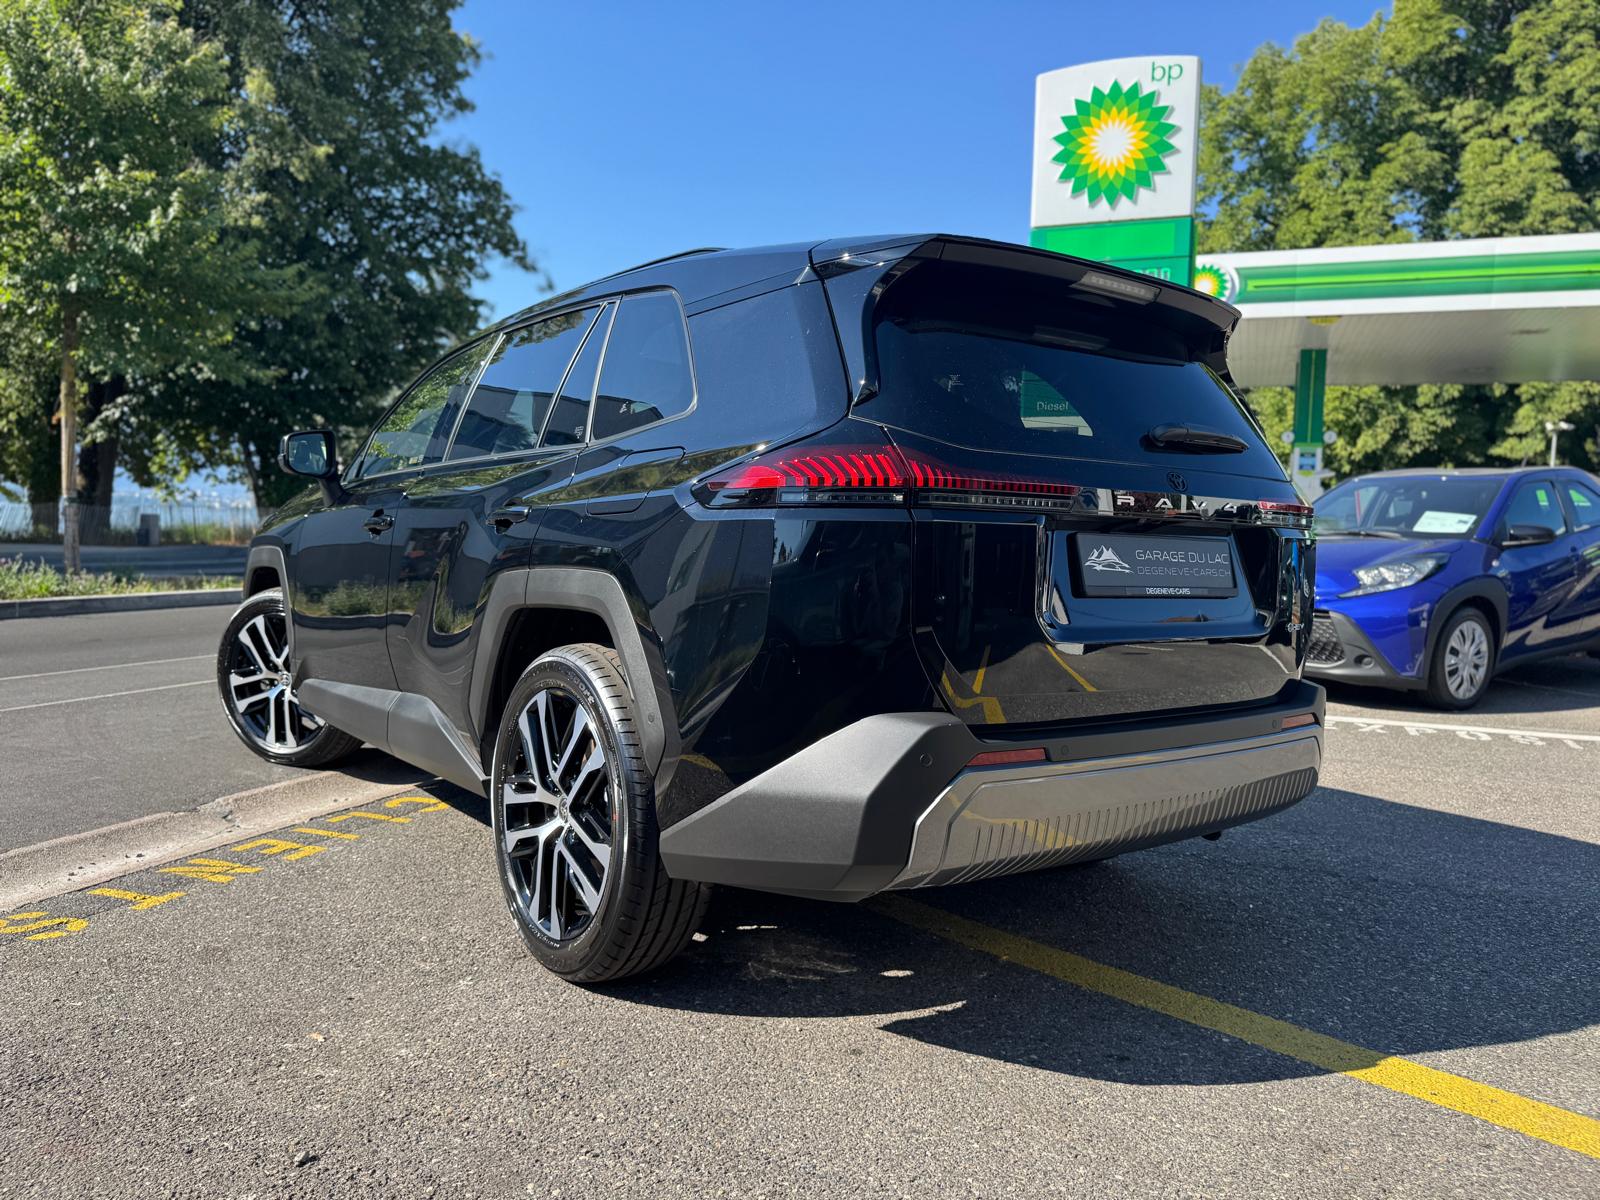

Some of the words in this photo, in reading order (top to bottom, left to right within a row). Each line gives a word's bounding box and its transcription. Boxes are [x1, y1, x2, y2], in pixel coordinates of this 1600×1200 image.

[1151, 61, 1183, 86] bp
[1036, 401, 1069, 412] Diesel
[1116, 495, 1238, 514] RAV4
[1135, 549, 1186, 562] GARAGE
[1188, 552, 1205, 563] DU
[1207, 553, 1229, 565] LAC
